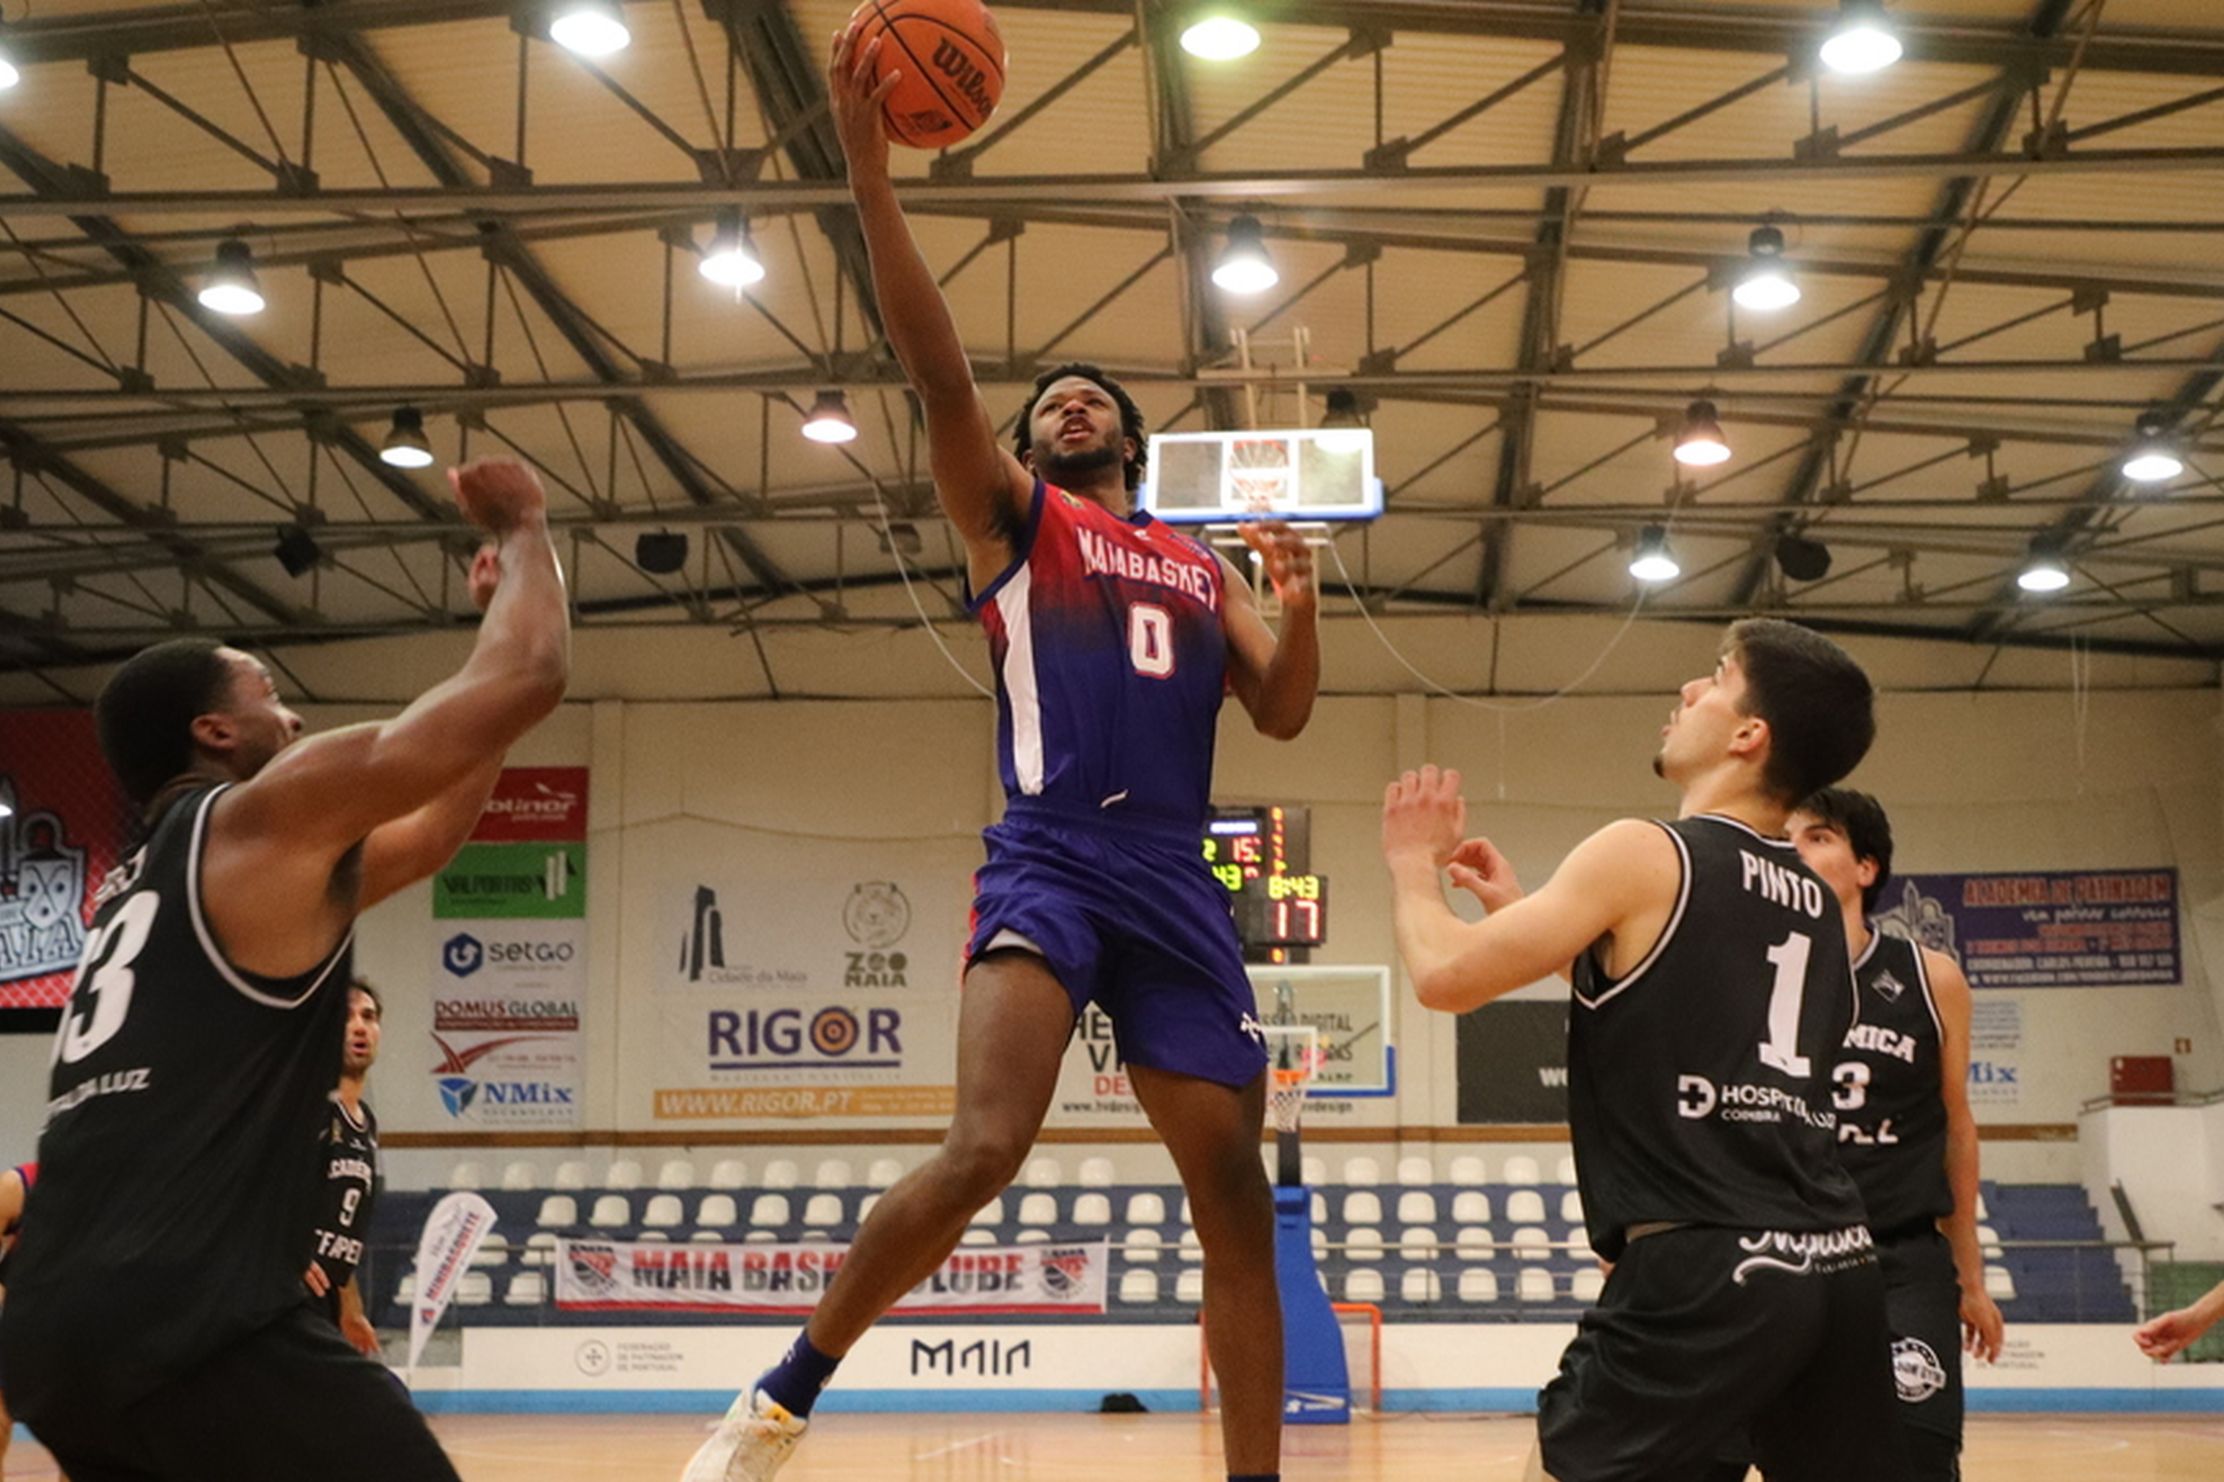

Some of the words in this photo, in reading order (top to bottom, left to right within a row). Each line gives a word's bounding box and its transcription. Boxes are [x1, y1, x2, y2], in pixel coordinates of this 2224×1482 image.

[1128, 600, 1178, 681] 0
[1739, 849, 1824, 919] PINTO
[1278, 900, 1318, 940] 17
[845, 952, 908, 972] ZOO
[436, 1001, 505, 1016] DOMUS
[508, 1001, 578, 1016] GLOBAL
[1758, 931, 1811, 1077] 1
[708, 1006, 903, 1057] RIGOR
[100, 1067, 152, 1093] LUZ
[483, 1082, 574, 1104] NMix
[660, 1090, 854, 1115] WWW.RIGOR.PT
[1721, 1107, 1782, 1124] COIMBRA
[338, 1187, 362, 1228] 9
[632, 1250, 732, 1292] MAIA
[910, 1254, 1024, 1295] LUBE
[911, 1339, 1031, 1376] MAIA
